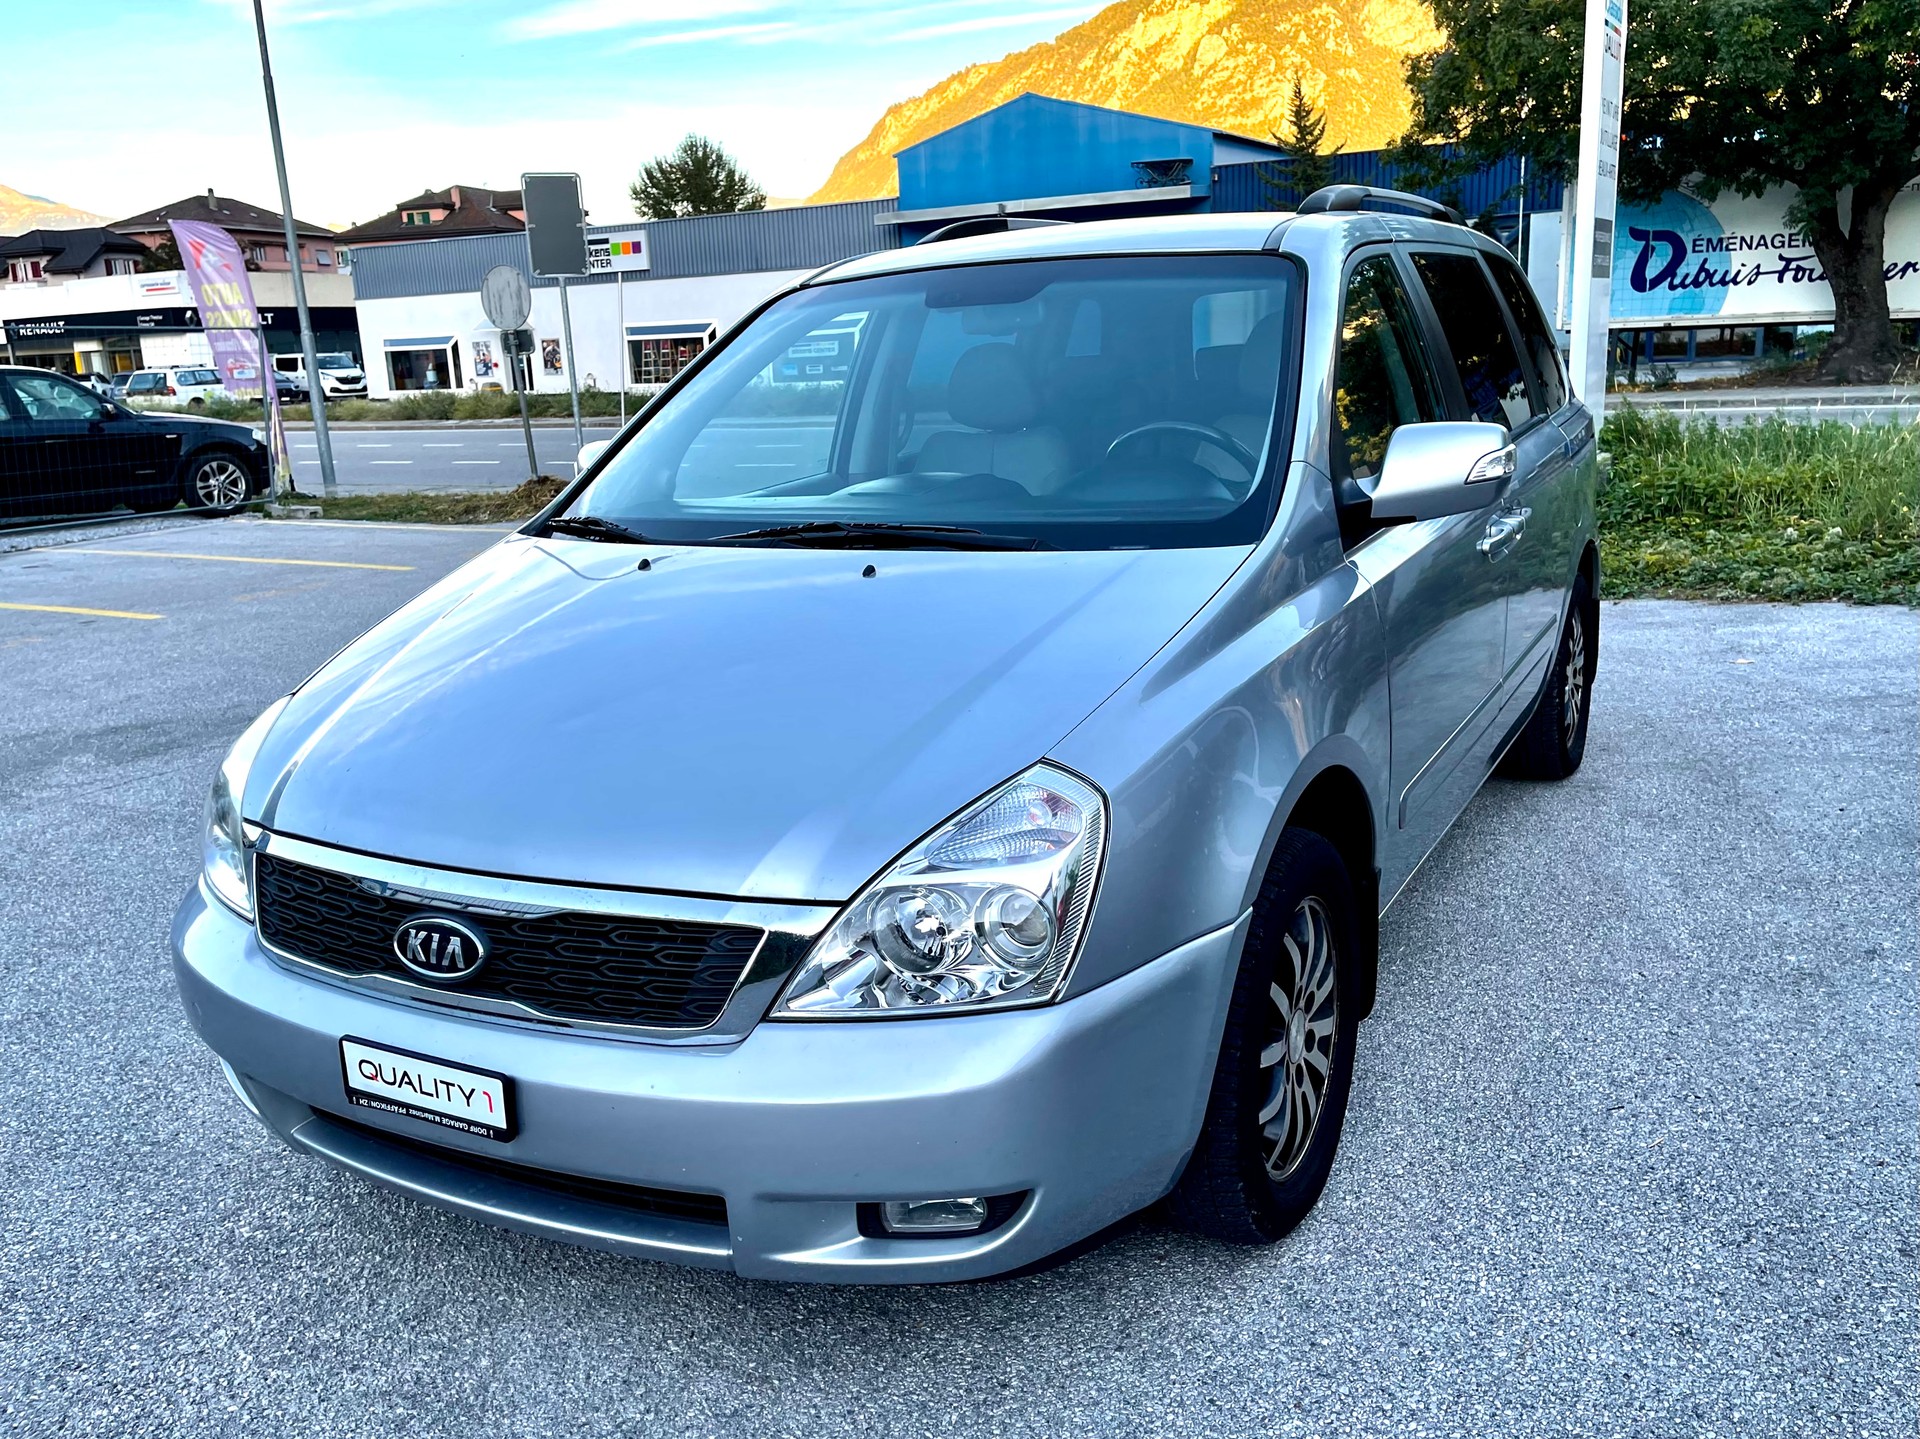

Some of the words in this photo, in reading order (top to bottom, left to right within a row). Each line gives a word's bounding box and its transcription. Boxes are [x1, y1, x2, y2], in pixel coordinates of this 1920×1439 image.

[589, 246, 611, 258] kens
[590, 258, 612, 269] NTER
[1628, 226, 1761, 293] Dubuis
[19, 321, 65, 336] RENAULT
[407, 929, 465, 969] KIA
[358, 1059, 476, 1107] QUALITY
[482, 1091, 494, 1113] 1
[441, 1117, 469, 1131] GARAGE
[469, 1125, 487, 1136] DORF
